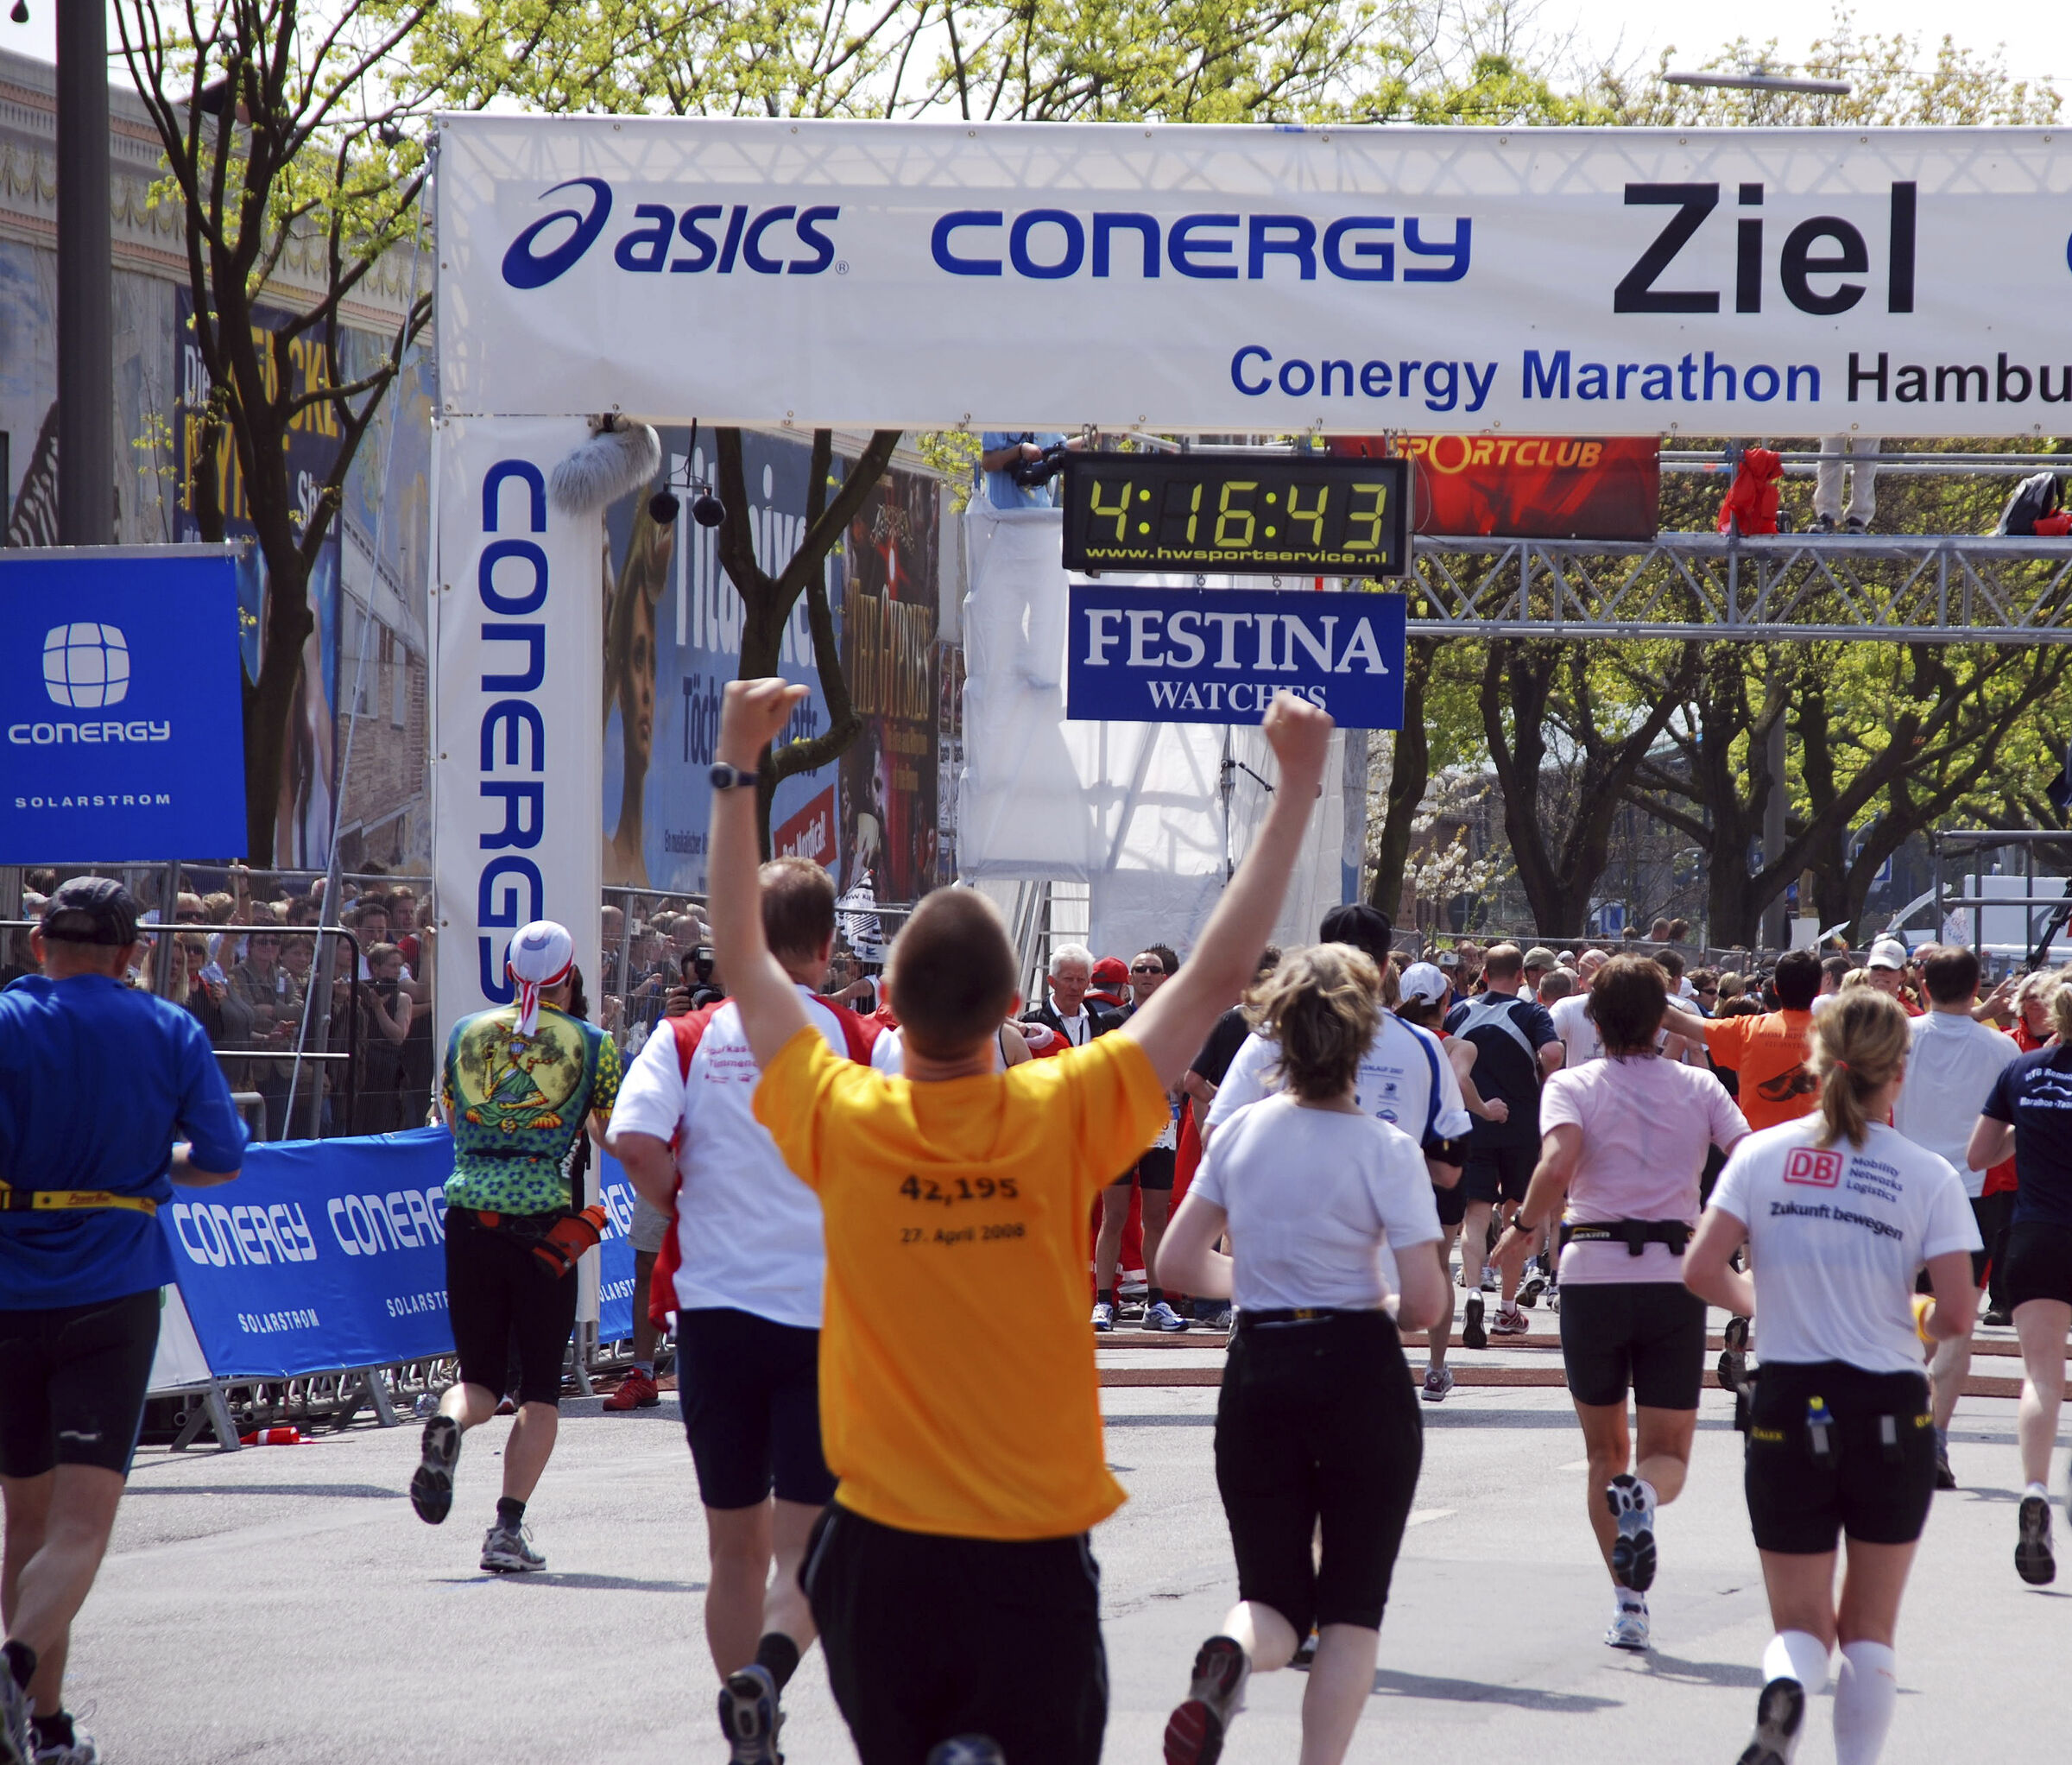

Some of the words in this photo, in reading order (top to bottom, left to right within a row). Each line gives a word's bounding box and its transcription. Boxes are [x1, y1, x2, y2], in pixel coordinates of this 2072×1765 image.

[614, 204, 840, 275] asics
[931, 208, 1472, 282] CONERGY
[1614, 181, 1917, 315] Ziel
[1230, 345, 1498, 411] Conergy
[1522, 349, 1821, 402] Marathon
[1848, 351, 2072, 402] Hambu
[1388, 434, 1603, 473] SPORTCLUB
[1090, 480, 1387, 550] 4:16:43
[1086, 547, 1387, 565] www.hwsportservice.nl
[1084, 609, 1389, 674] FESTINA
[9, 720, 170, 744] CONERGY
[16, 794, 171, 808] SOLARSTROM
[1791, 1152, 1835, 1180] DB
[1848, 1167, 1904, 1192] Networks
[1851, 1155, 1901, 1178] Mobility
[900, 1174, 1020, 1207] 42,195
[1845, 1180, 1897, 1203] Logistics
[174, 1201, 318, 1268] CONERGY
[326, 1186, 446, 1256] CONERG
[932, 1226, 976, 1246] April
[1771, 1200, 1831, 1219] Zukunft
[1833, 1205, 1905, 1242] bewegen
[237, 1307, 320, 1334] SOLARSTROM
